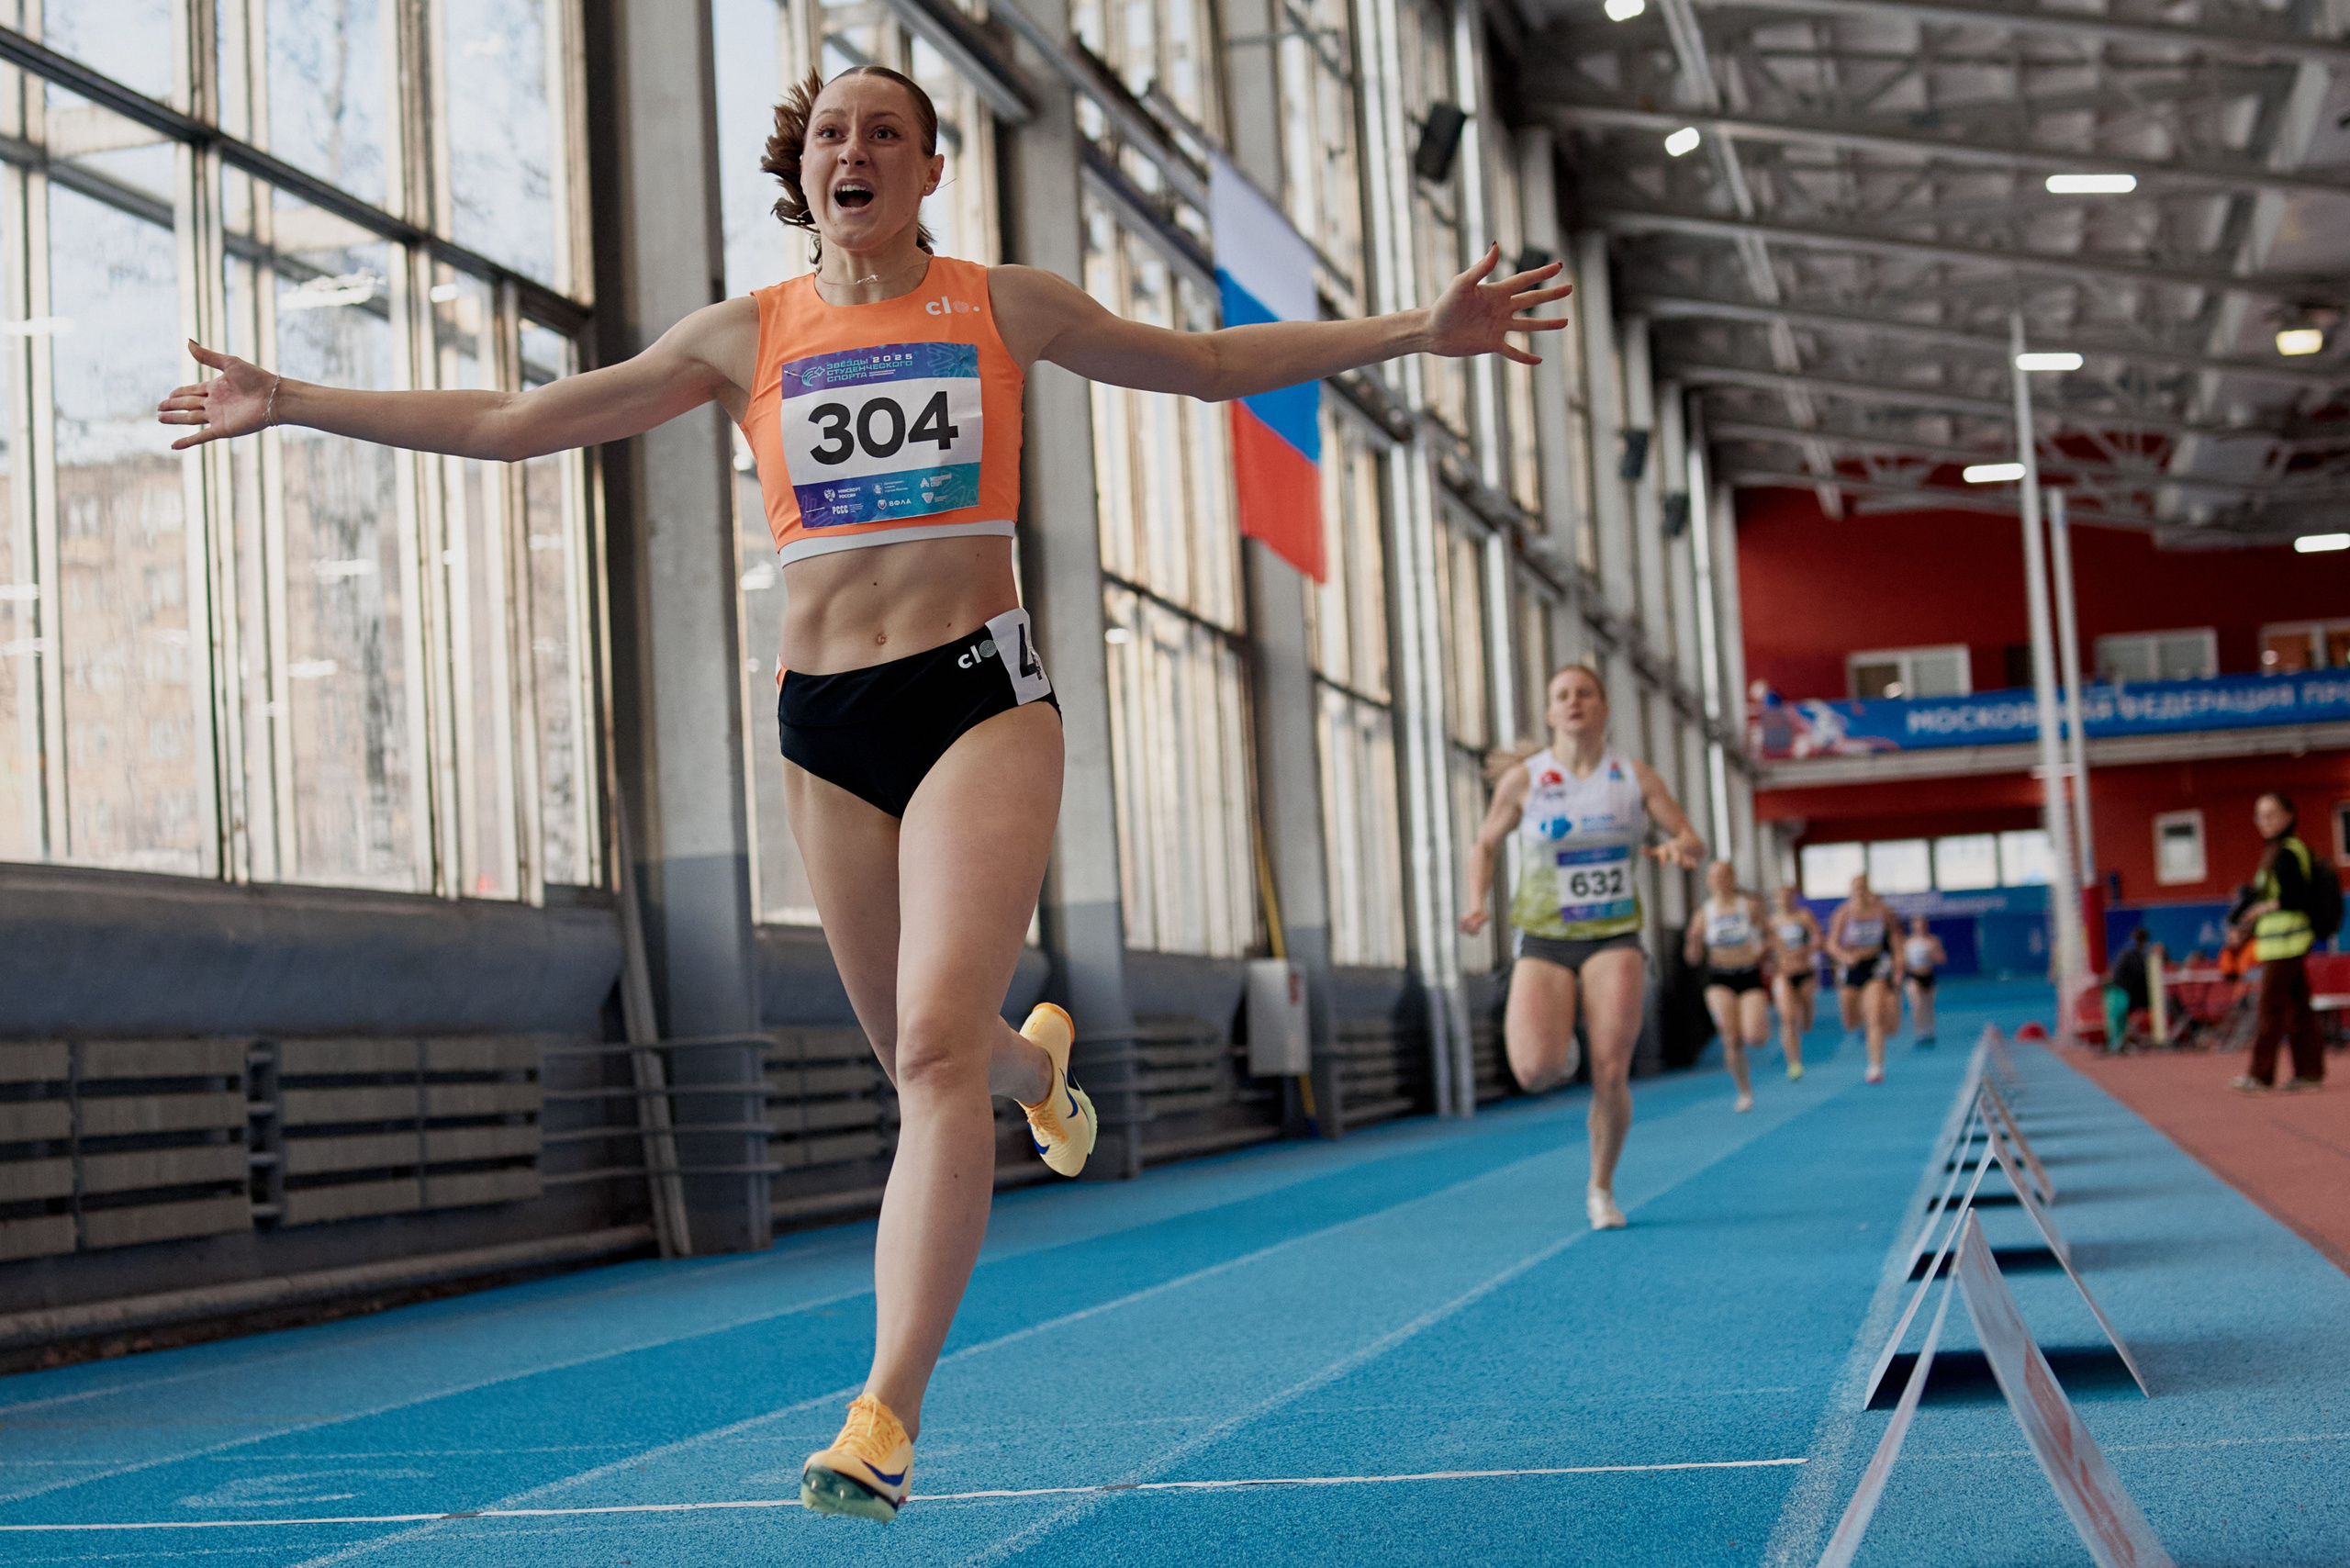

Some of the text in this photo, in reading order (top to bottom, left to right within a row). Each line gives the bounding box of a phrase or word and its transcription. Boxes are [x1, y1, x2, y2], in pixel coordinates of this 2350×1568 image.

[872, 353, 913, 364] 2025
[827, 360, 912, 376] СТУДЕНЧЕСКОГО
[827, 372, 867, 383] СПОРТА
[808, 390, 959, 465] 304
[889, 498, 912, 507] ВФЛА
[832, 504, 849, 515] РССС
[1570, 868, 1624, 898] 632
